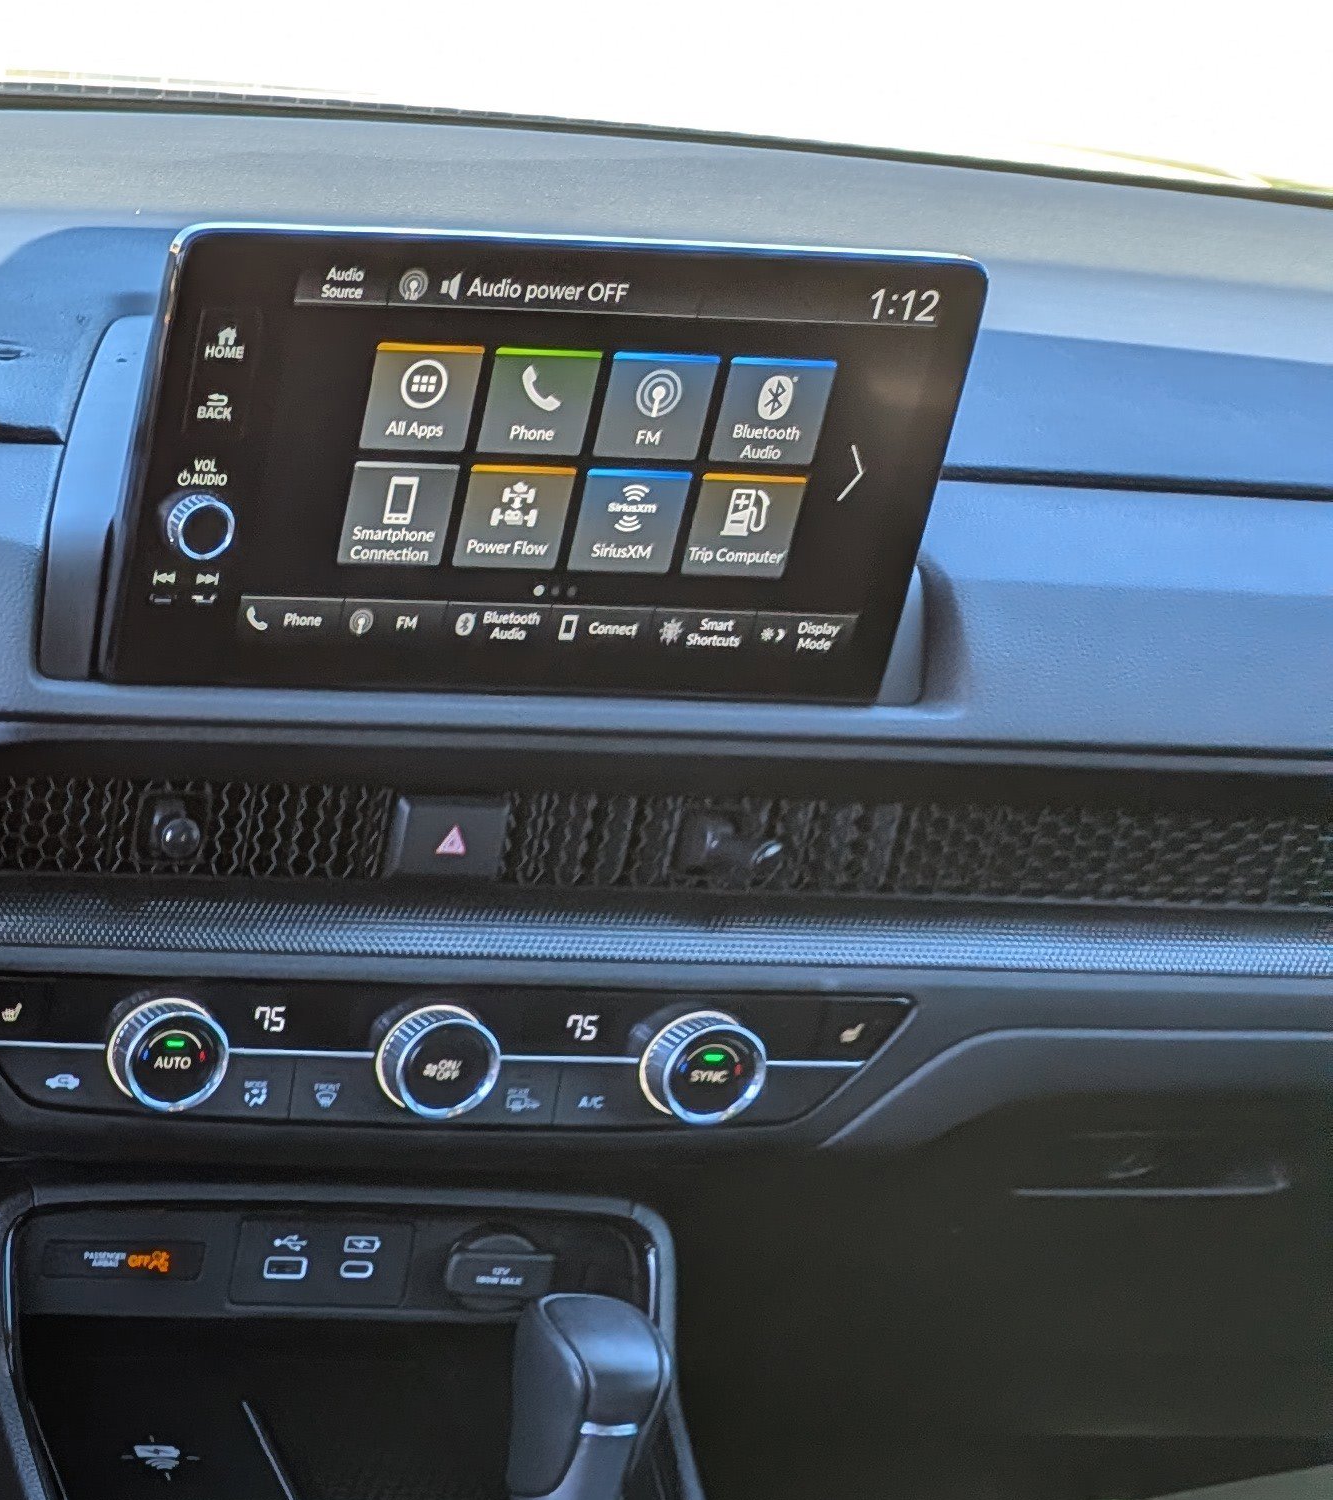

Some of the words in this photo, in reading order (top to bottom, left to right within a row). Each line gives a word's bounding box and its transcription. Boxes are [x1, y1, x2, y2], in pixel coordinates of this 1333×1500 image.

[326, 266, 364, 282] Audio
[321, 284, 363, 299] Source
[467, 277, 522, 298] Audio
[525, 281, 584, 302] power
[587, 281, 630, 301] OFF
[870, 288, 939, 322] 1:12
[205, 345, 244, 359] HOME
[196, 406, 232, 421] BACK
[385, 421, 405, 437] All
[407, 422, 444, 439] Apps
[509, 425, 555, 442] Phone
[732, 423, 801, 442] Bluetooth
[636, 430, 662, 446] FM
[740, 444, 782, 460] Audio
[194, 459, 217, 472] VOL
[191, 473, 228, 486] AUDIO
[352, 526, 436, 545] Smartphone
[350, 546, 429, 562] Connection
[466, 540, 510, 555] Power
[513, 541, 548, 556] Flow
[591, 543, 653, 559] SiriusXM
[688, 547, 715, 565] Trip
[716, 548, 784, 566] Computer
[283, 613, 323, 627] Phone
[395, 616, 418, 629] FM
[482, 611, 541, 626] Bluetooth
[700, 618, 734, 632] Smart
[489, 627, 526, 641] Audio
[588, 622, 638, 637] Connect
[797, 621, 841, 638] Display
[686, 633, 741, 648] Shortcuts
[796, 637, 832, 651] Mode
[254, 1005, 286, 1032] 75
[566, 1014, 600, 1041] 75
[153, 1055, 192, 1070] AUTO
[435, 1069, 460, 1081] OFF
[689, 1069, 729, 1084] SYNC
[578, 1096, 605, 1110] A/C
